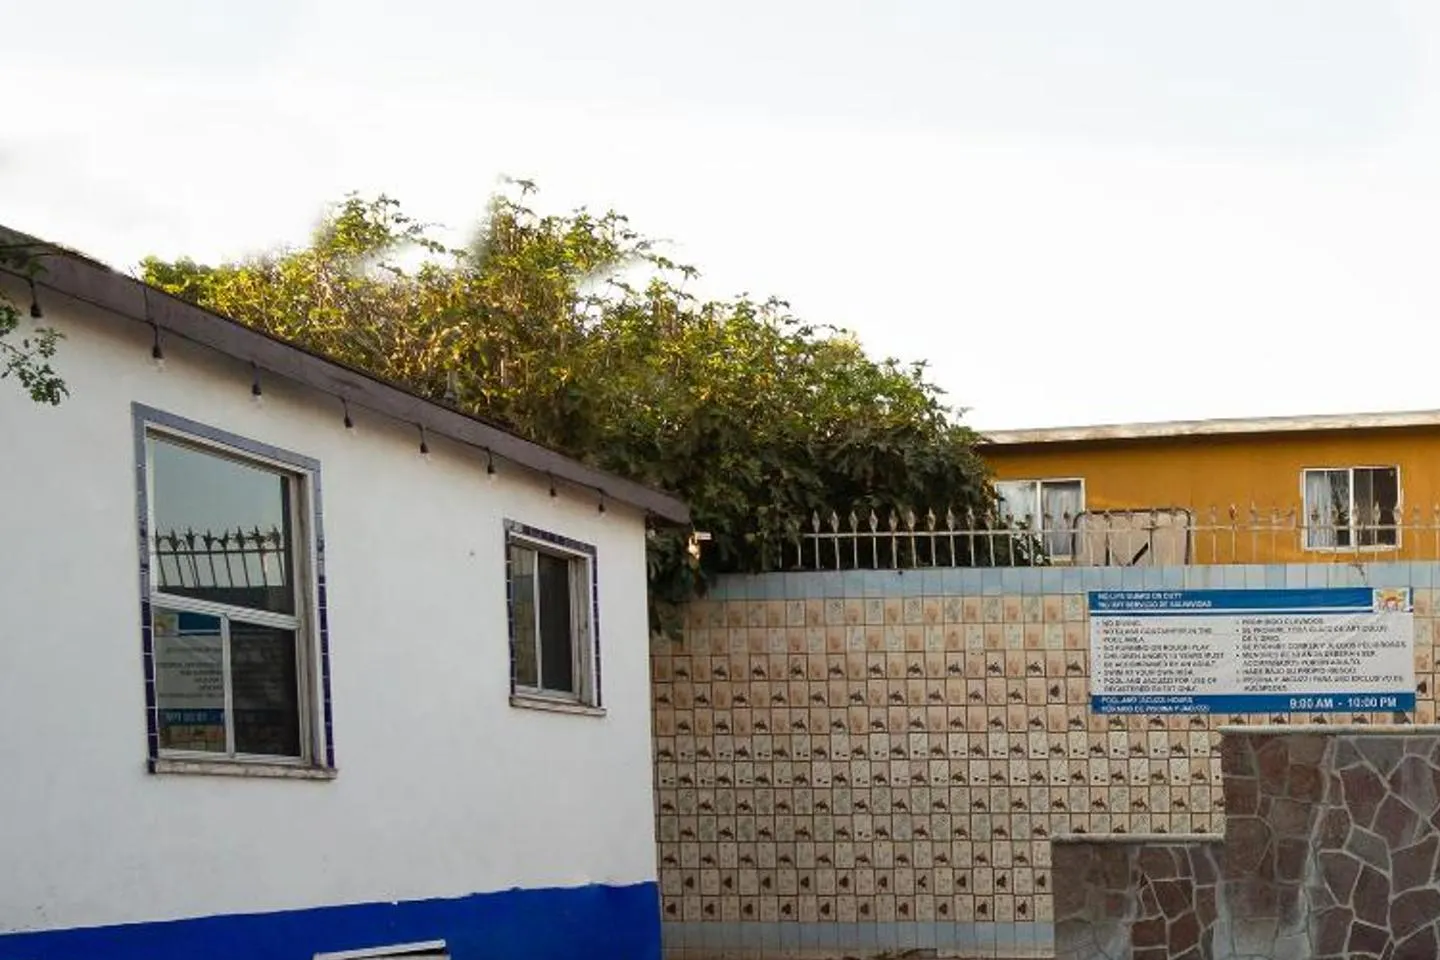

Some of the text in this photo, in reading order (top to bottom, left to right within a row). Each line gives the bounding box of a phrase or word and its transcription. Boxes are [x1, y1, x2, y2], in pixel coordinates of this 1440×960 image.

[1315, 698, 1334, 708] AM
[1347, 697, 1378, 708] 10:00
[1380, 697, 1397, 708] PM
